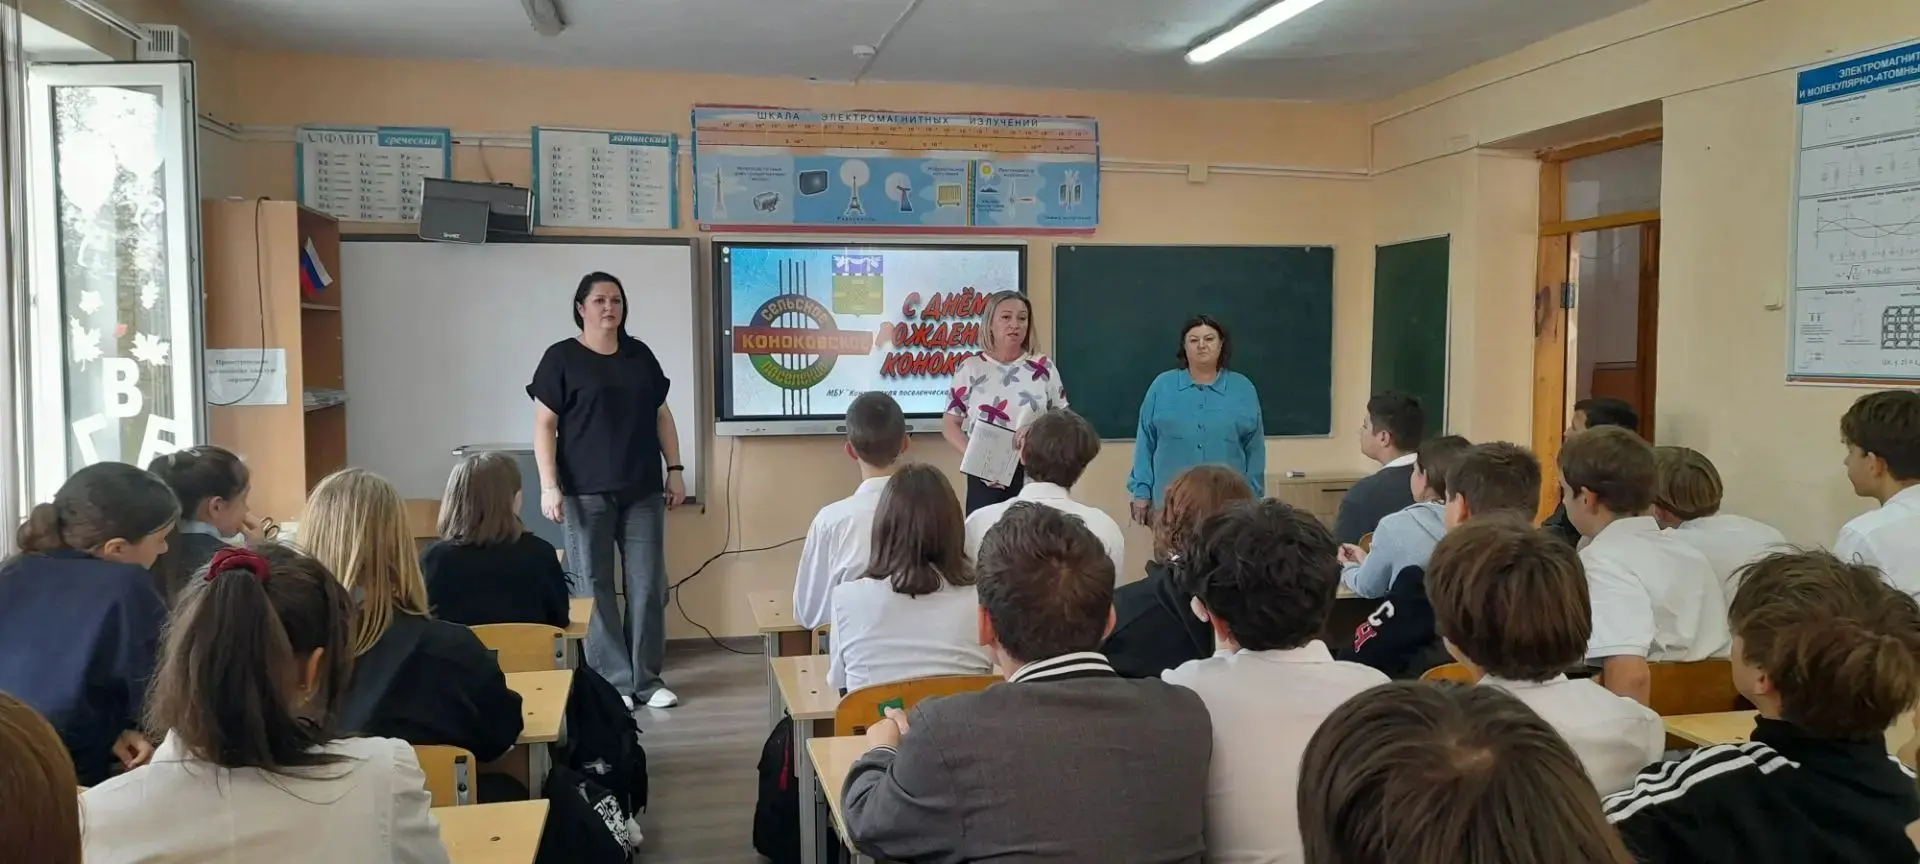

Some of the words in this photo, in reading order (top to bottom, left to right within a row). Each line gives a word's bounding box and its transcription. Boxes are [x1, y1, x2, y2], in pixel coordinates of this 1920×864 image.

[1838, 51, 1920, 78] ЭЛЕКТРОМАГНИТ
[1799, 89, 1806, 99] И
[1807, 63, 1920, 97] МОЛЕКУЛЯРНО-АТОМНЫ
[757, 111, 800, 120] ШКАЛА
[821, 112, 949, 124] ЭЛЕКТРОМАГНИТНЫХ
[969, 116, 1039, 127] ИЗЛУЧЕНИЙ
[306, 131, 376, 145] АЛФАВИТ
[384, 135, 438, 146] греческий
[902, 291, 921, 318] С
[920, 286, 992, 322] ДНЁМ
[742, 333, 870, 351] КОНОКОВСКОЕ
[875, 320, 980, 351] РОЖДЕН
[880, 350, 974, 378] КОНОК
[826, 388, 845, 397] МБУ
[899, 389, 950, 397] поселенческа
